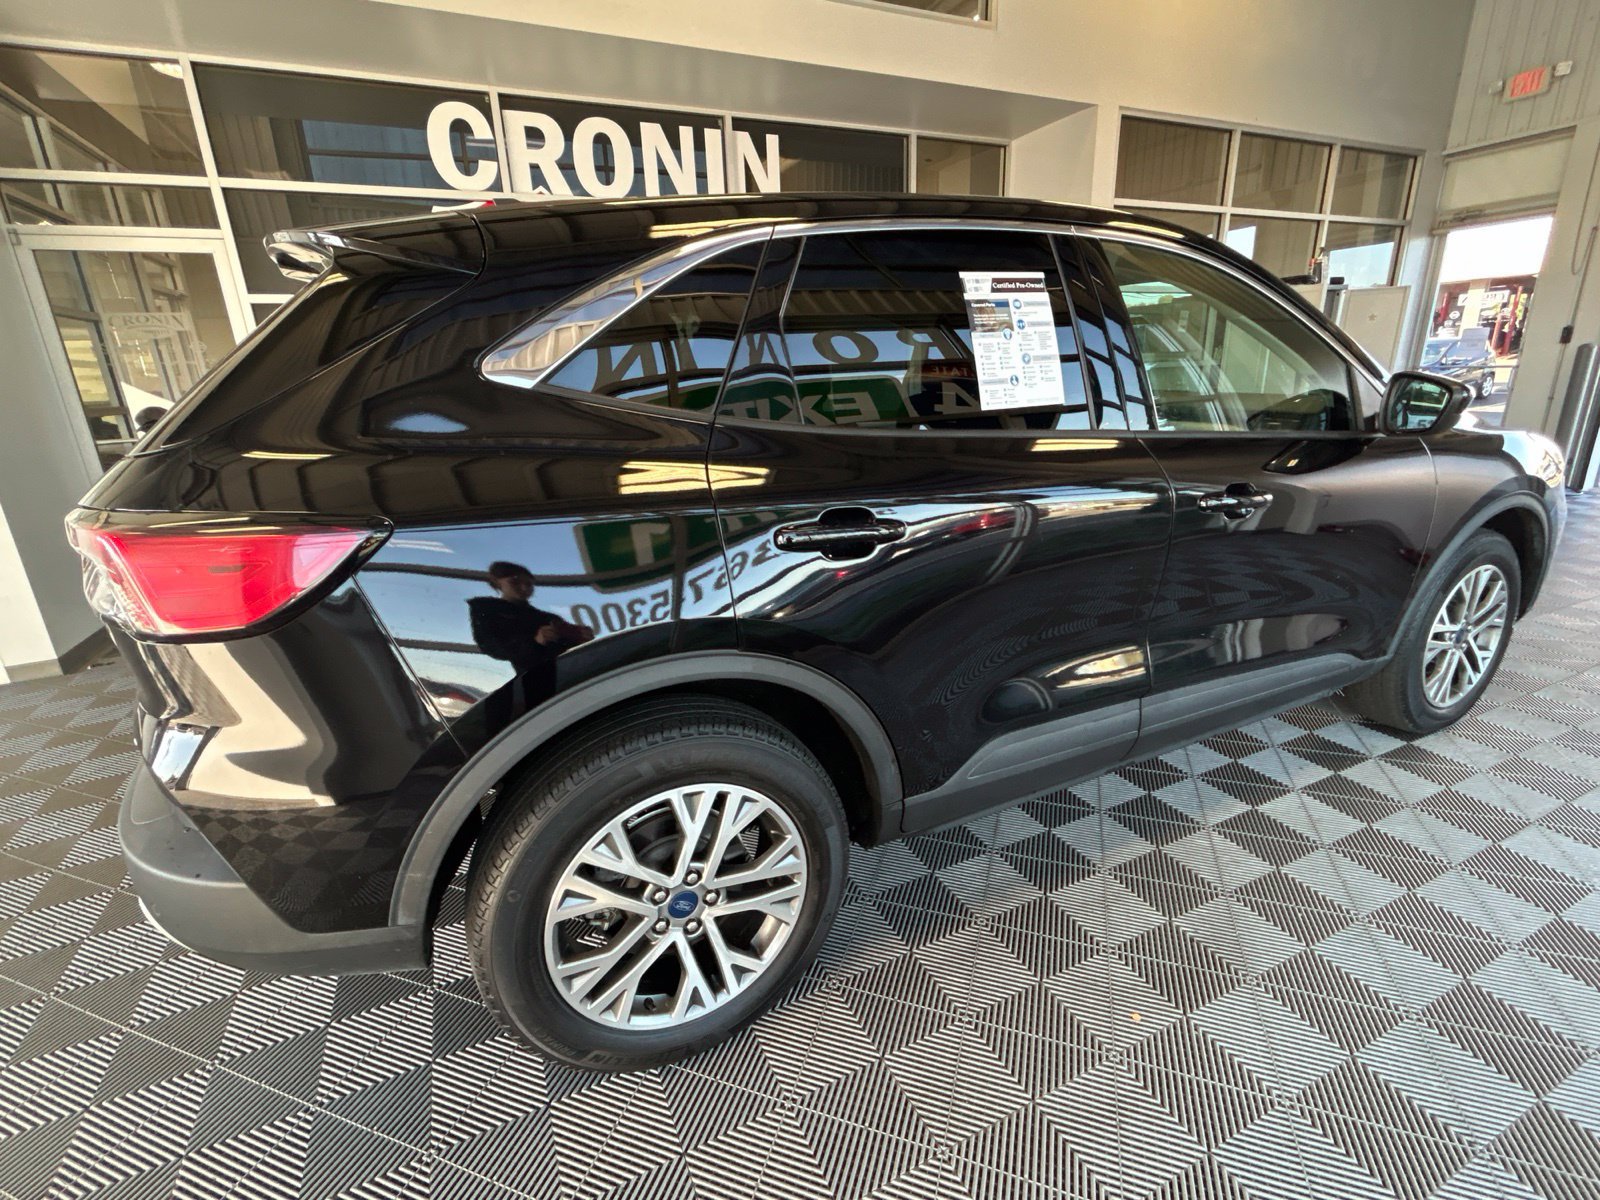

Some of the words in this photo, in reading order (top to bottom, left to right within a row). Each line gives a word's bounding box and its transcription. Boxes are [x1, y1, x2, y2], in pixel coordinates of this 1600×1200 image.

[426, 101, 781, 198] CRONIN
[992, 281, 1016, 290] Certified
[1016, 282, 1045, 290] Pre-Owned
[107, 313, 186, 329] CRONIN
[674, 900, 694, 911] Ford
